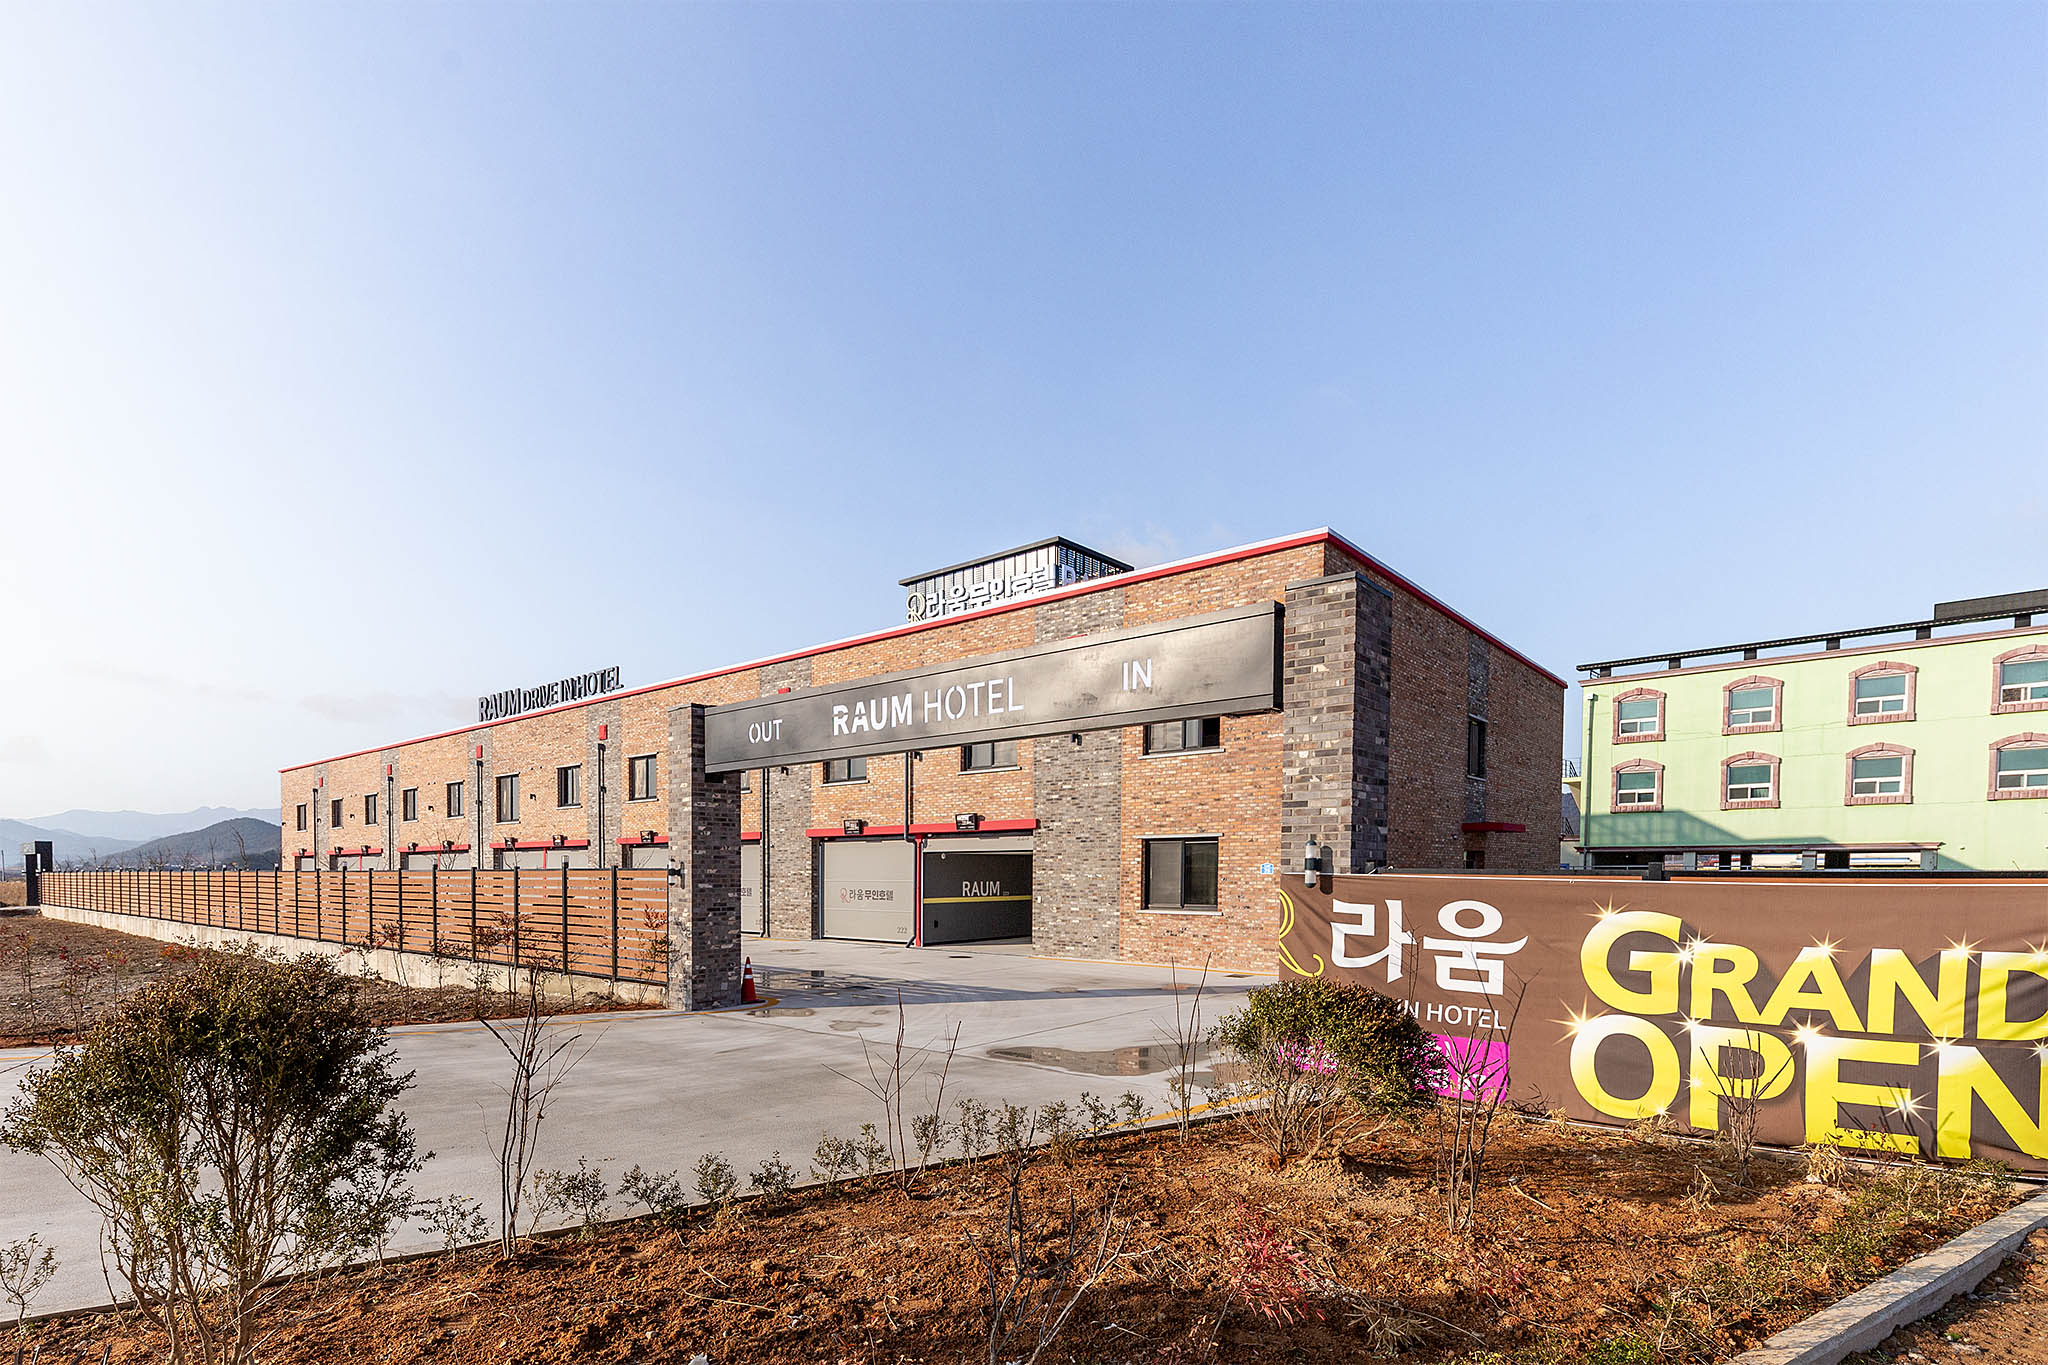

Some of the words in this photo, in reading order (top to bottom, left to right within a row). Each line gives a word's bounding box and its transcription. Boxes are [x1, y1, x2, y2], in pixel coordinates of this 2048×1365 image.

[479, 688, 522, 722] RAUM
[522, 682, 559, 712] DRIVE
[576, 665, 624, 700] HOTEL
[1121, 658, 1152, 691] IN
[748, 719, 783, 744] OUT
[832, 694, 913, 736] RAUM
[923, 676, 1024, 722] HOTEL
[962, 880, 1000, 897] RAUM
[1330, 899, 1528, 995] 라움
[1580, 910, 2048, 1041] GRAND
[1426, 1003, 1507, 1030] HOTEL
[1570, 1014, 2048, 1160] OPEN
